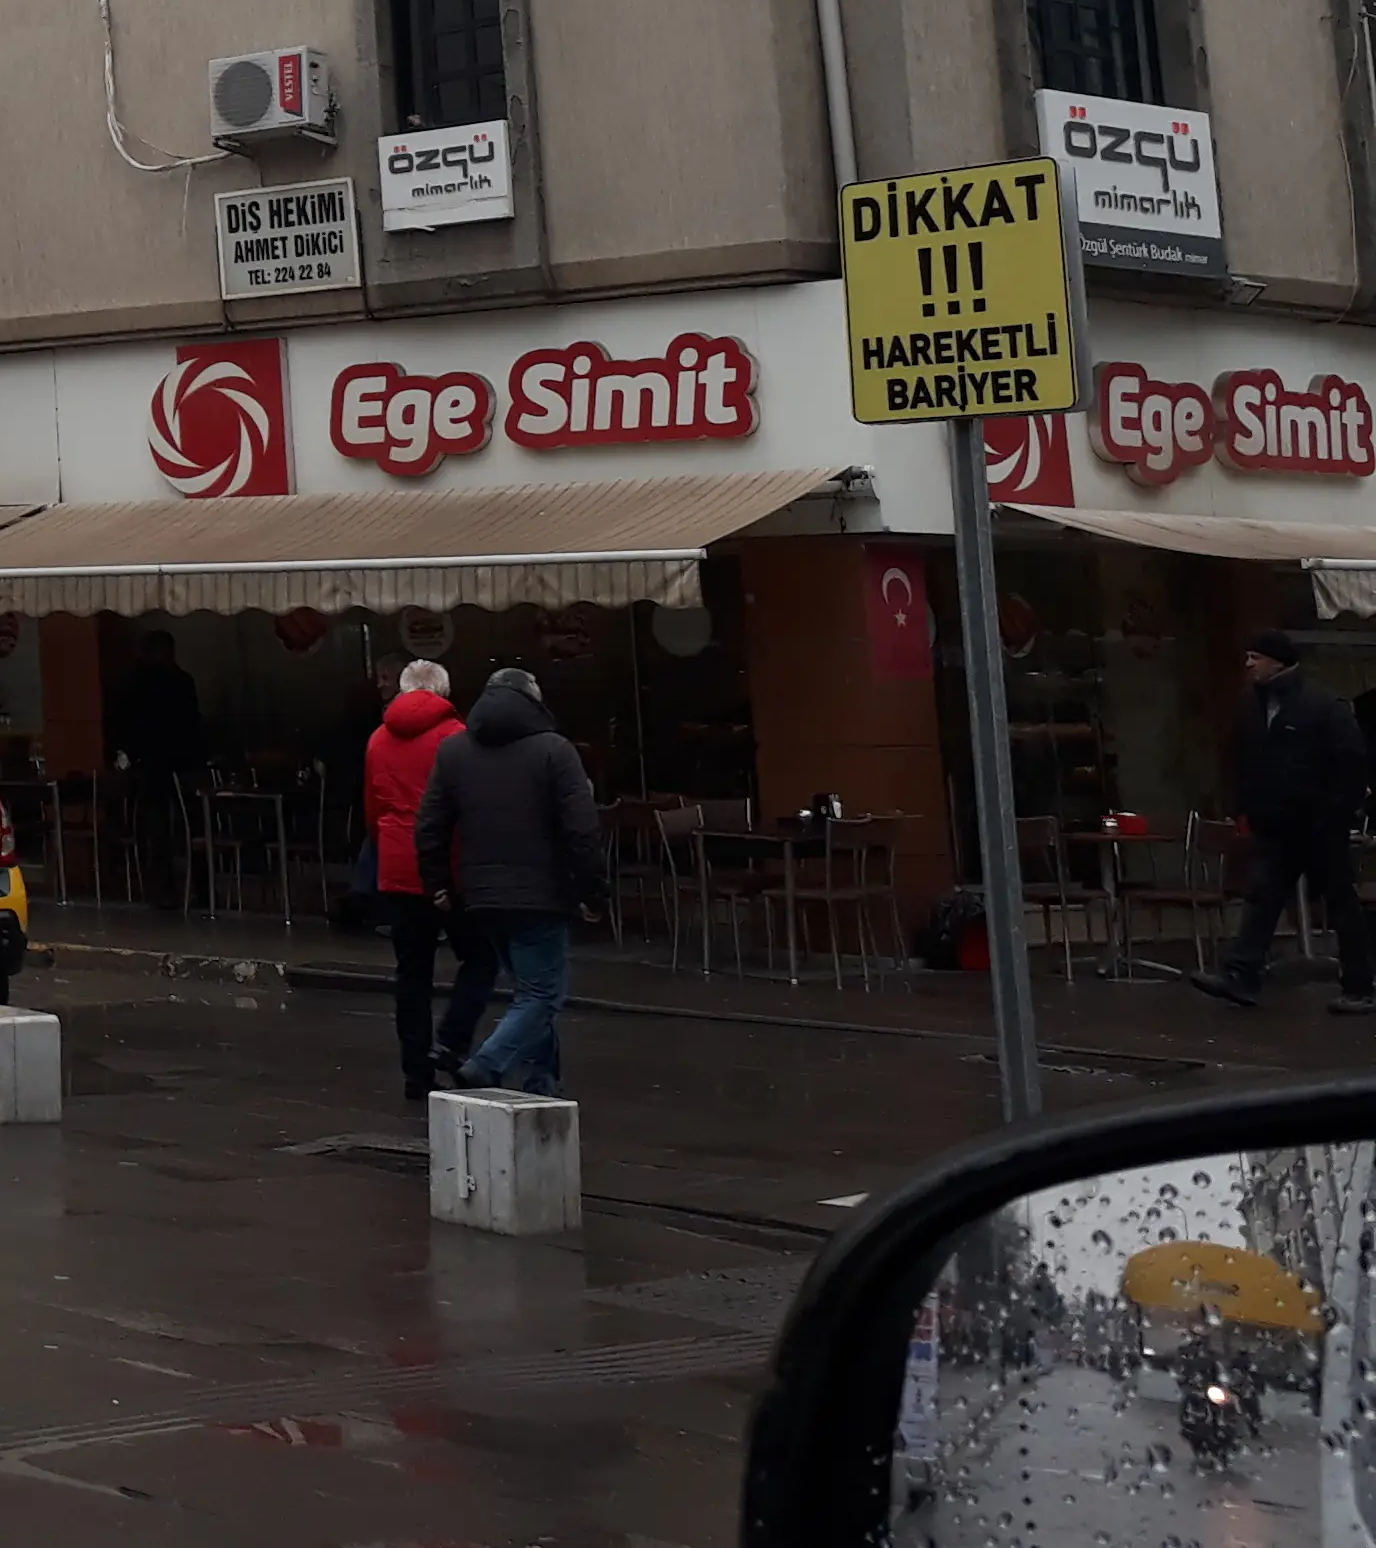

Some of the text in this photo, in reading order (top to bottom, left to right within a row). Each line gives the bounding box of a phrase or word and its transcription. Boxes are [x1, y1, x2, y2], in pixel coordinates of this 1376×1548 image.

[225, 190, 346, 234] DİŞ HEKİMİ
[851, 173, 1046, 242] DİKKAT
[1093, 185, 1202, 221] mimarlık
[233, 234, 289, 264] AHMET
[1150, 243, 1183, 262] Budak
[248, 261, 332, 286] TEL: 224 22 84
[861, 312, 1059, 371] HAREKETLİ
[342, 347, 738, 464] Ege Simit
[886, 364, 1040, 412] BARİYER
[1108, 374, 1369, 472] Ege Simit
